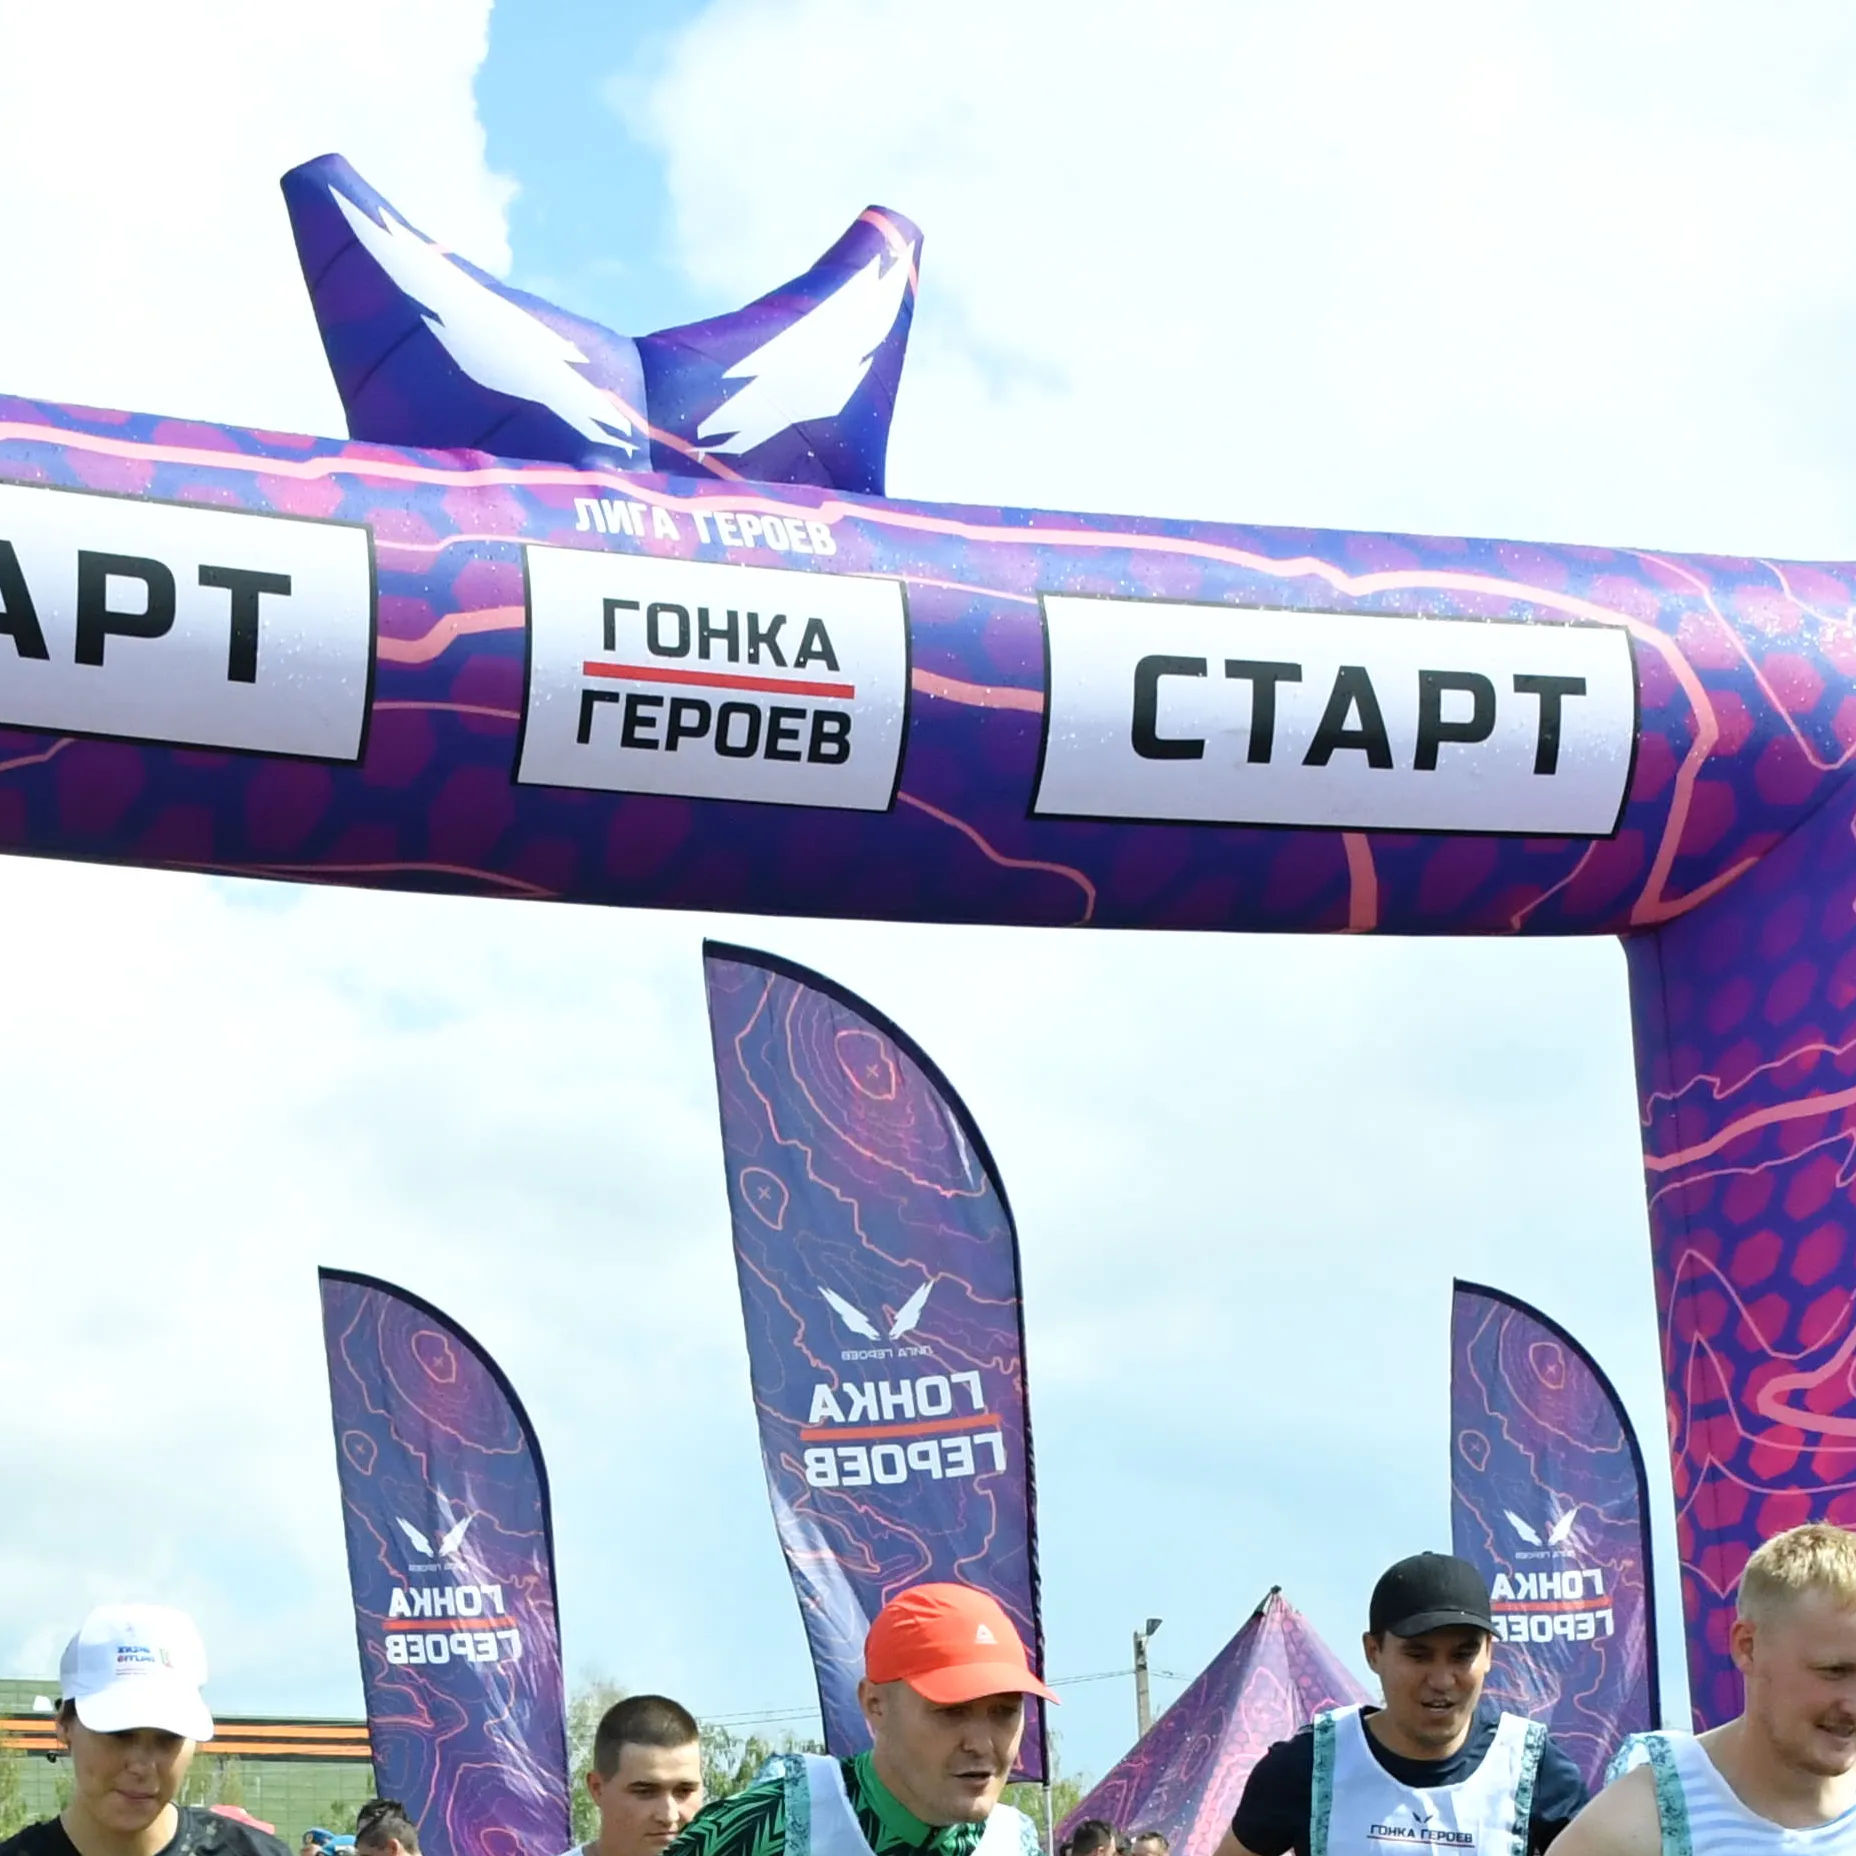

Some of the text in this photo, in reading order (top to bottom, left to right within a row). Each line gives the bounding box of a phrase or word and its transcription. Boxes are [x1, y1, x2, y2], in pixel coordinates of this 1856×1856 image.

[573, 497, 837, 556] ЛИГА ГЕРОЕВ
[602, 597, 841, 672] ГОНКА
[576, 688, 853, 766] ГЕРОЕВ
[1129, 654, 1587, 777] СТАРТ
[1370, 1824, 1474, 1844] ГОНКА ГЕРОЕВ
